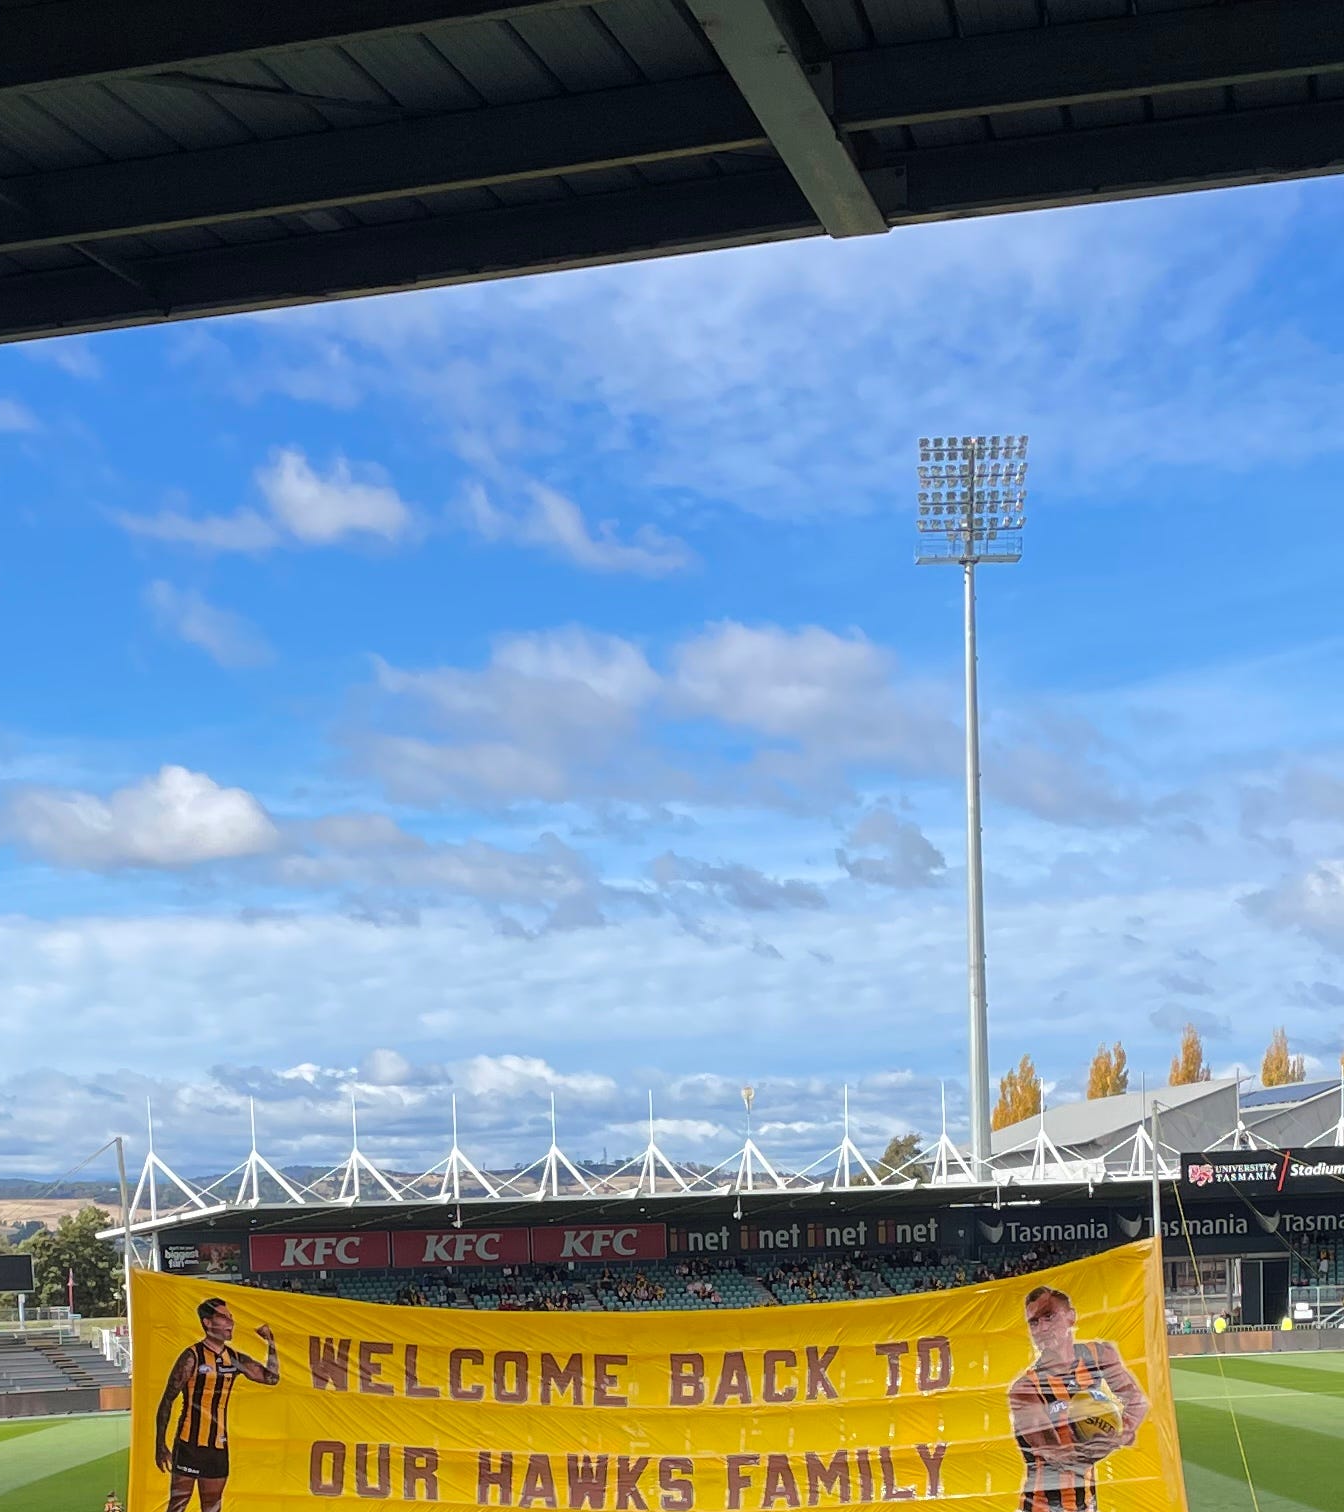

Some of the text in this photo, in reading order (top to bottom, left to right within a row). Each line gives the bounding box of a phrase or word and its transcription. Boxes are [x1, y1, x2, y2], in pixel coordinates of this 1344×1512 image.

[1215, 1163, 1269, 1173] UNIVERSITY
[1215, 1172, 1277, 1182] TASMANIA
[1006, 1218, 1109, 1242] Tasmania
[1144, 1213, 1248, 1237] Tasmania
[164, 1249, 199, 1261] biggest
[280, 1237, 361, 1267] KFC
[422, 1233, 502, 1262] KFC
[560, 1228, 639, 1257] KFC
[308, 1335, 953, 1407] WELCOME BACK TO
[309, 1440, 949, 1512] OUR HAWKS FAMILY
